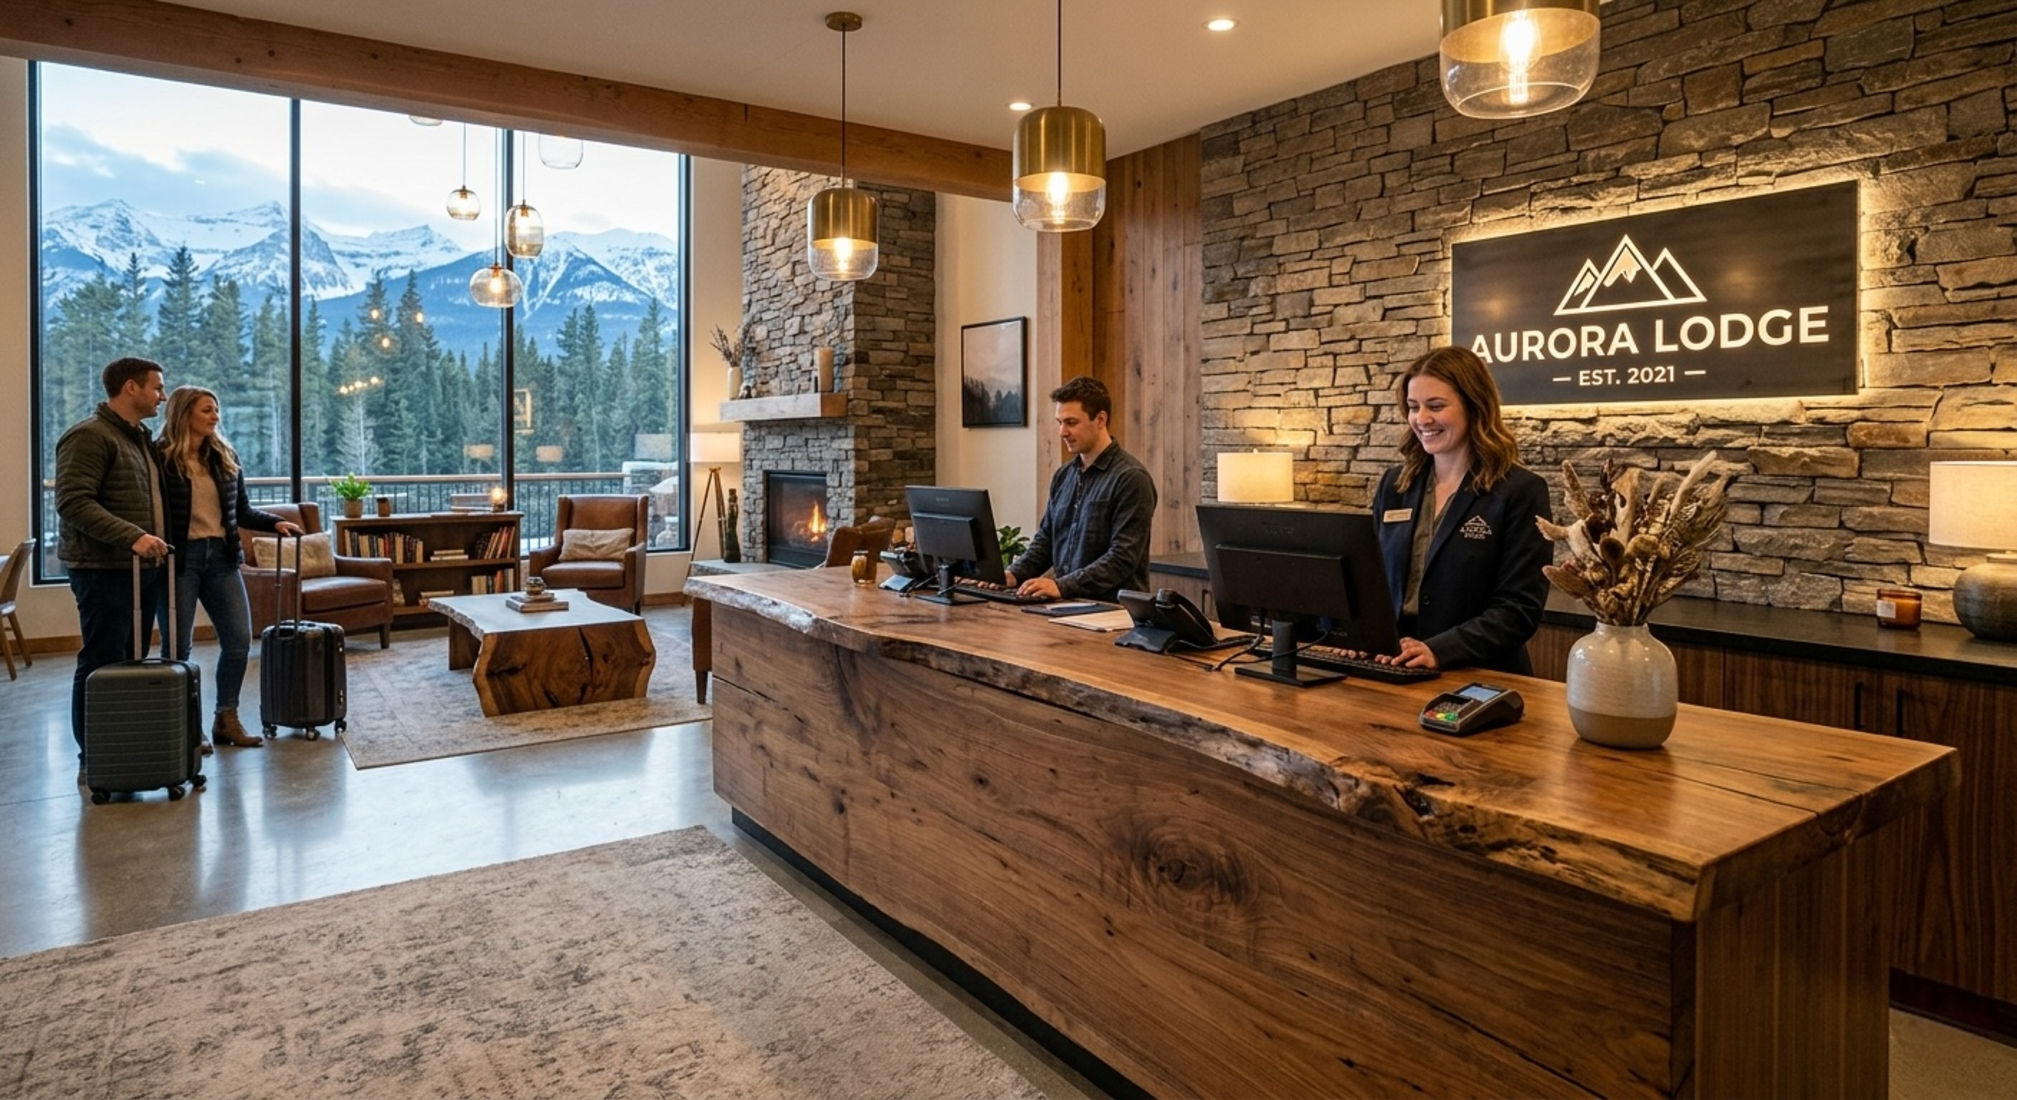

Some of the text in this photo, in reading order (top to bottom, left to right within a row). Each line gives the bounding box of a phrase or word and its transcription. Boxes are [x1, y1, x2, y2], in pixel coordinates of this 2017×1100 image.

[1470, 305, 1830, 364] AURORA LODGE
[1579, 365, 1675, 386] EST. 2021
